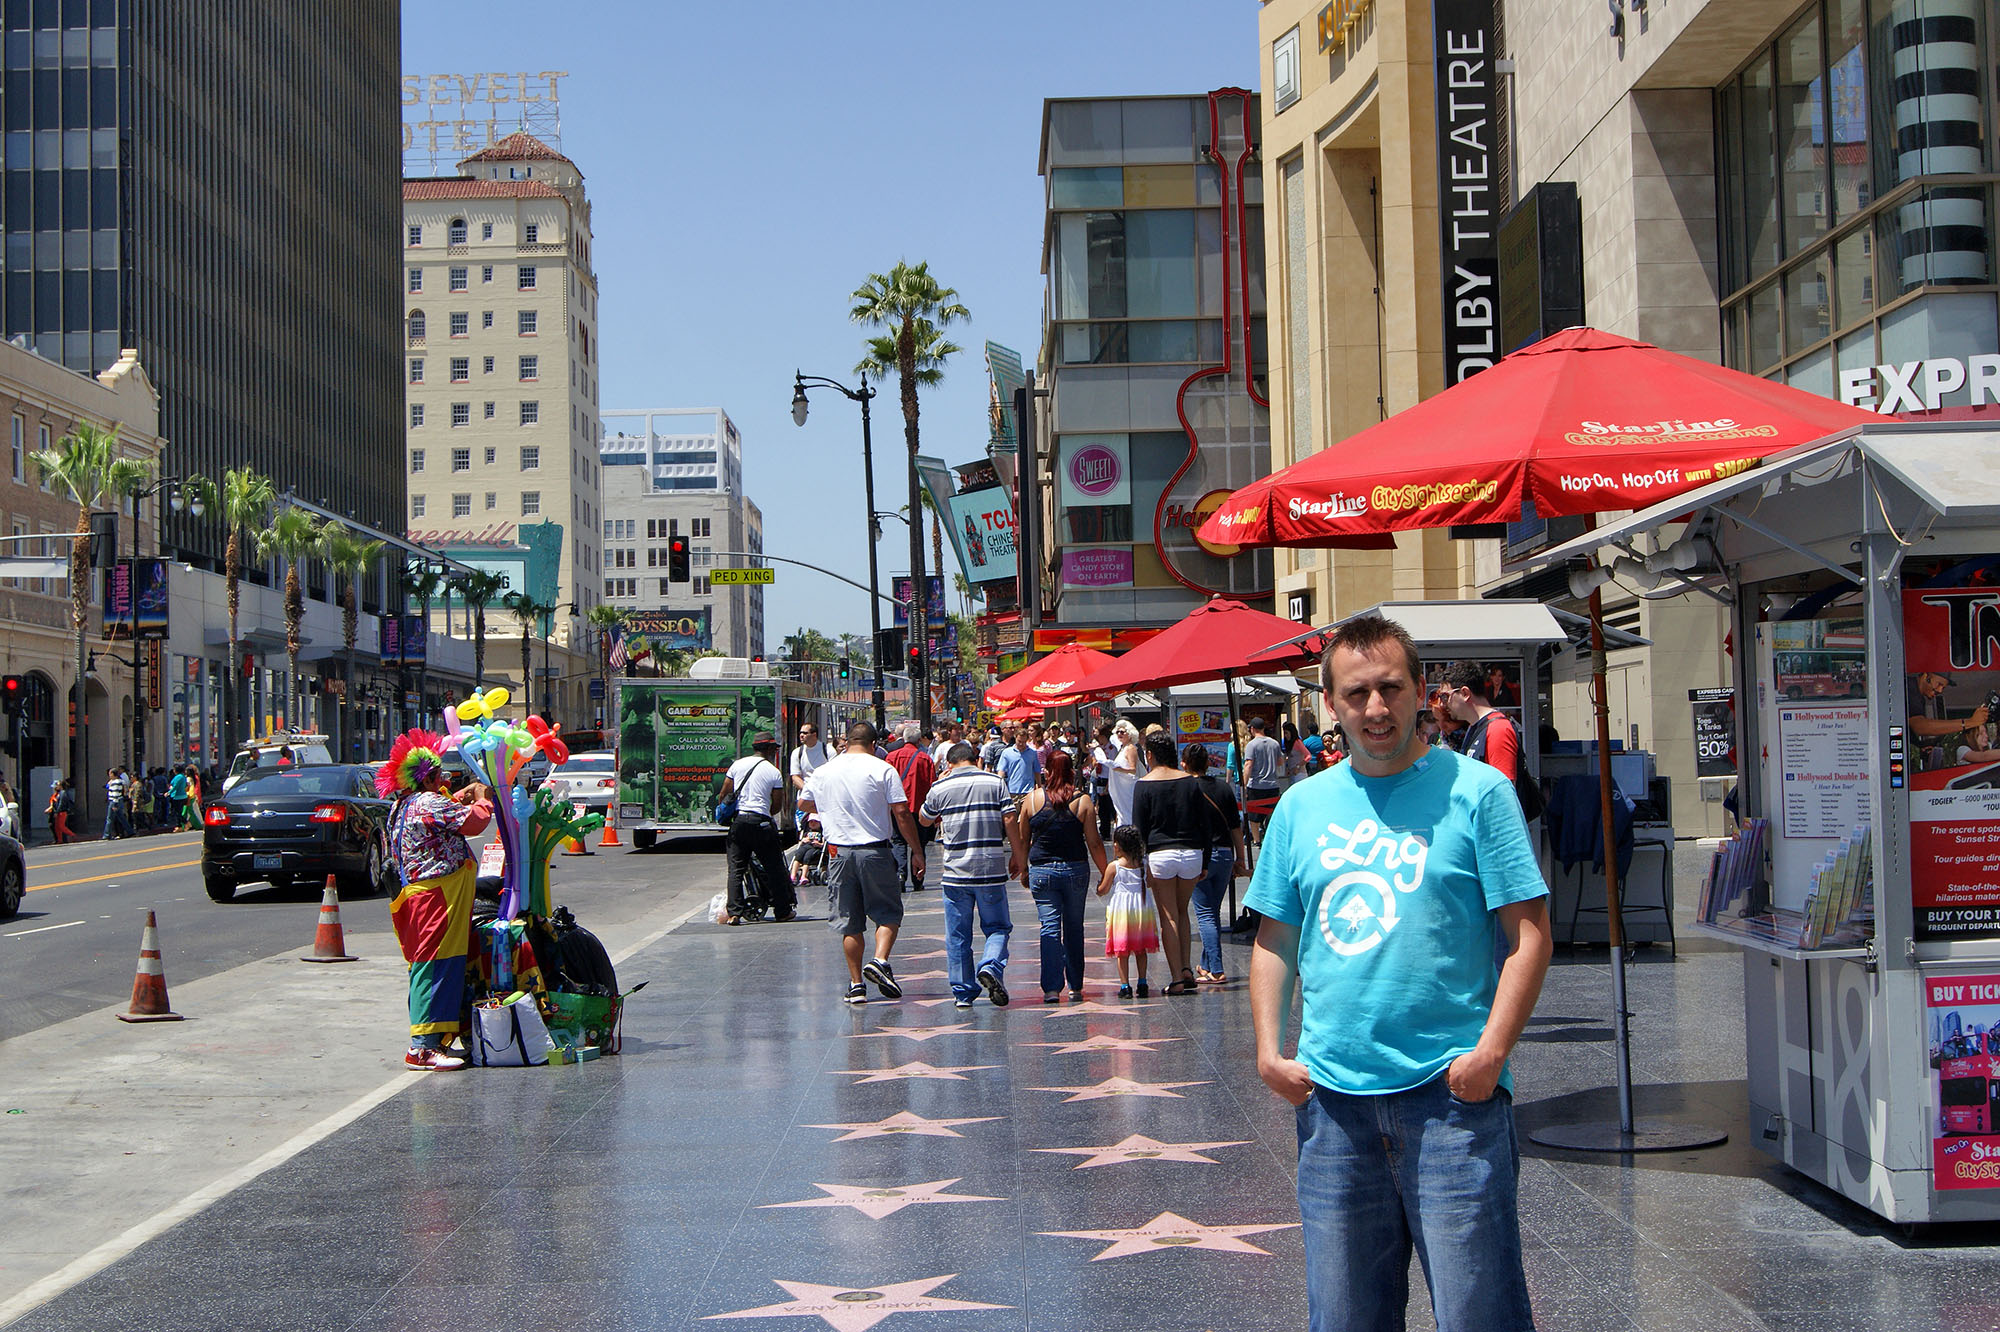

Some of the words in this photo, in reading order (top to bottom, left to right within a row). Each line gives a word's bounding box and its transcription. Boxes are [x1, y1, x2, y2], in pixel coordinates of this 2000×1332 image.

[1447, 28, 1491, 251] THEATRE
[1079, 456, 1113, 486] SWEET!
[1560, 472, 1618, 492] Hop-On,
[1622, 468, 1679, 491] Hop-Off
[1289, 491, 1368, 521] StarLine
[1371, 479, 1497, 511] CitySightseeing
[981, 509, 1013, 531] TCL
[1079, 555, 1116, 563] GREATEST
[1071, 564, 1098, 572] CANDY
[1100, 563, 1125, 571] STORE
[715, 572, 738, 582] PED
[743, 571, 770, 581] XING
[1078, 573, 1092, 581] ON
[1094, 572, 1119, 580] EARTH
[115, 565, 129, 612] PRISCILLA
[668, 707, 690, 715] GAME
[703, 707, 727, 715] TRUCK
[1179, 713, 1199, 724] FREE
[1795, 711, 1834, 723] Hollywood
[1835, 711, 1861, 722] Trolley
[1699, 741, 1720, 757] 50
[1720, 740, 1729, 749] %
[1797, 772, 1833, 784] Hollywood
[1834, 772, 1859, 781] Double
[1931, 826, 1947, 834] The
[1949, 825, 1976, 834] secret
[1977, 825, 2000, 835] spots
[1955, 835, 1986, 844] Sunset
[1934, 855, 1953, 864] Tour
[1955, 854, 1985, 865] guides
[1982, 863, 1999, 872] and
[1936, 892, 1973, 902] hilarious
[1928, 911, 1954, 922] BUY
[1956, 910, 1991, 921] YOUR
[1928, 923, 1968, 932] FREQUENT
[1933, 986, 1965, 1002] BUY
[783, 1304, 854, 1312] LANZA
[865, 1302, 932, 1310] MARIO
